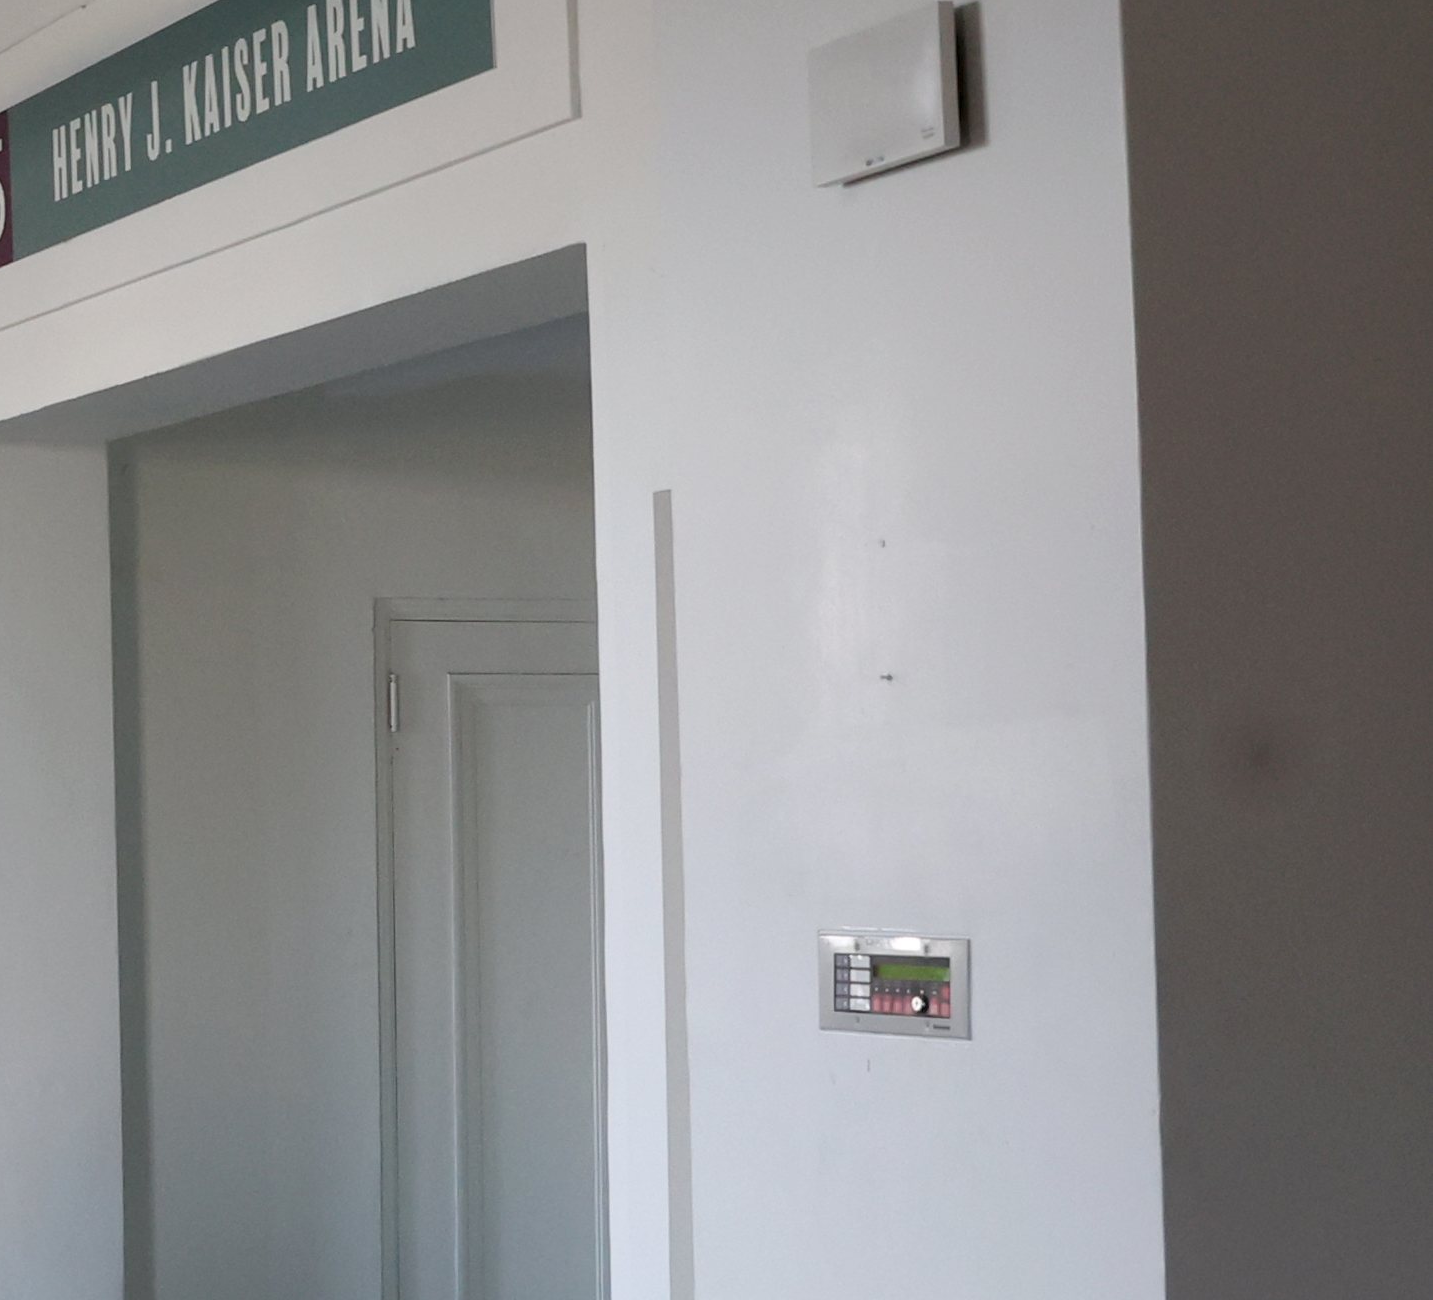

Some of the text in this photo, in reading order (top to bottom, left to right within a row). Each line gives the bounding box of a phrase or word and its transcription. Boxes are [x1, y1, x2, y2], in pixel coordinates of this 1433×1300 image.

[52, 91, 134, 203] HENRY
[146, 79, 172, 162] J.
[182, 19, 292, 146] KAISER
